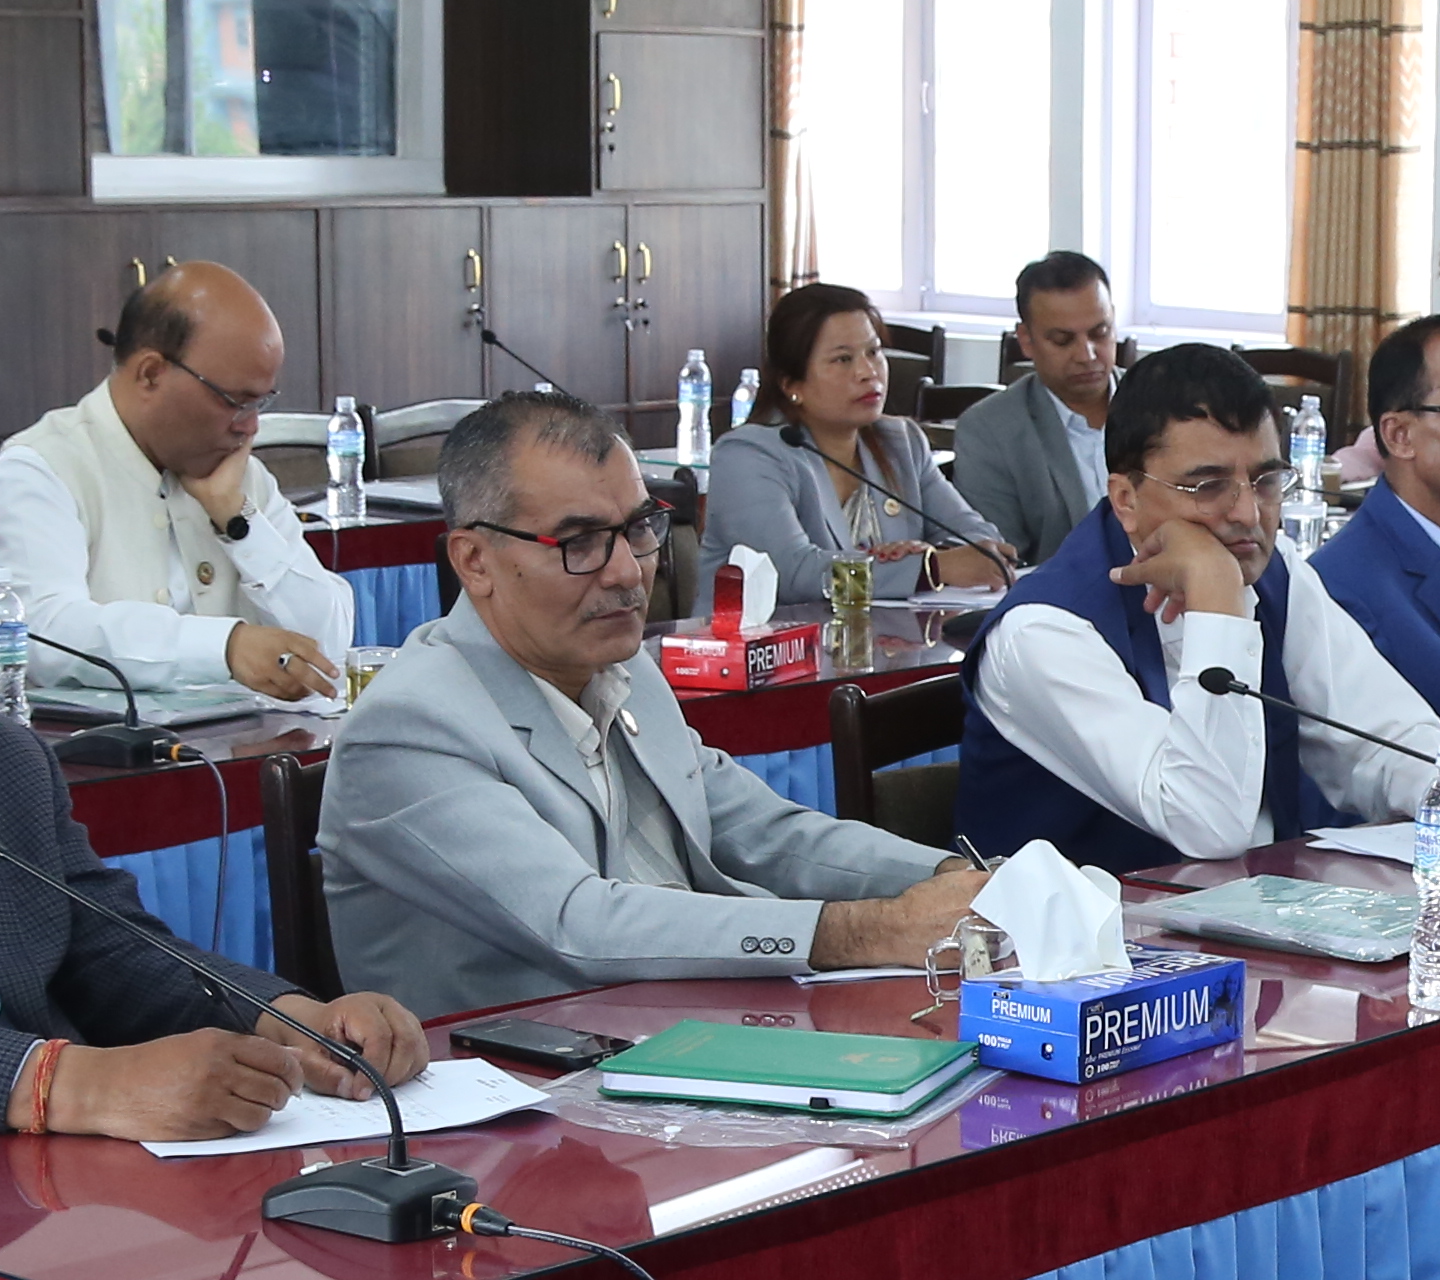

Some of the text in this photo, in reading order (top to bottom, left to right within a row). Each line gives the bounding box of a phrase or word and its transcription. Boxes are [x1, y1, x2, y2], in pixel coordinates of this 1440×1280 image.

[748, 637, 805, 673] PREMIUM
[1079, 956, 1224, 988] PREMIUM
[992, 999, 1051, 1024] PREMIUM
[1085, 985, 1209, 1055] PREMIUM
[978, 1033, 997, 1047] 100
